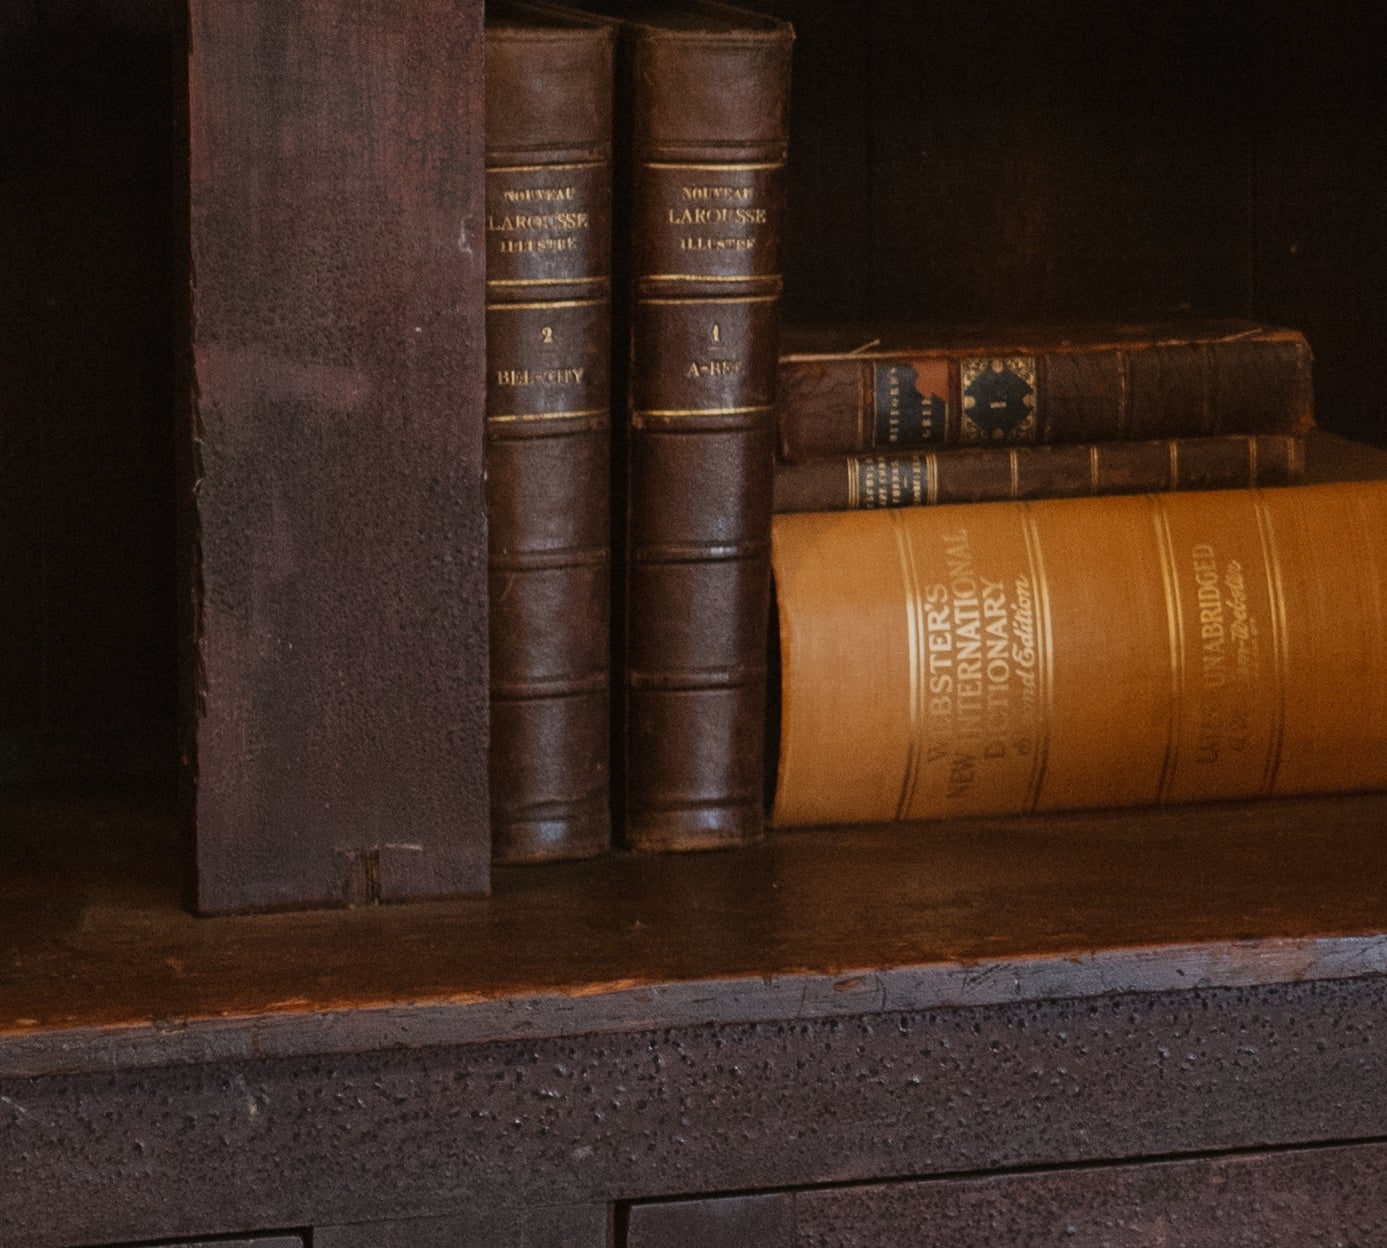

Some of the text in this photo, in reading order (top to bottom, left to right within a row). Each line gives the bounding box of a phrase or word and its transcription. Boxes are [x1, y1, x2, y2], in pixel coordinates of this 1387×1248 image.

[488, 212, 590, 232] LAROUSSE
[504, 186, 577, 203] NOUVEAU
[669, 207, 768, 225] LAROUSSE
[541, 326, 553, 344] 2
[711, 323, 720, 343] 1
[943, 527, 983, 751] INTERNATIONAL
[1011, 574, 1036, 669] Edition
[1192, 543, 1226, 689] UNABRIDGED
[925, 582, 953, 762] WEBSTER'S
[980, 574, 1011, 758] DICTIONARY
